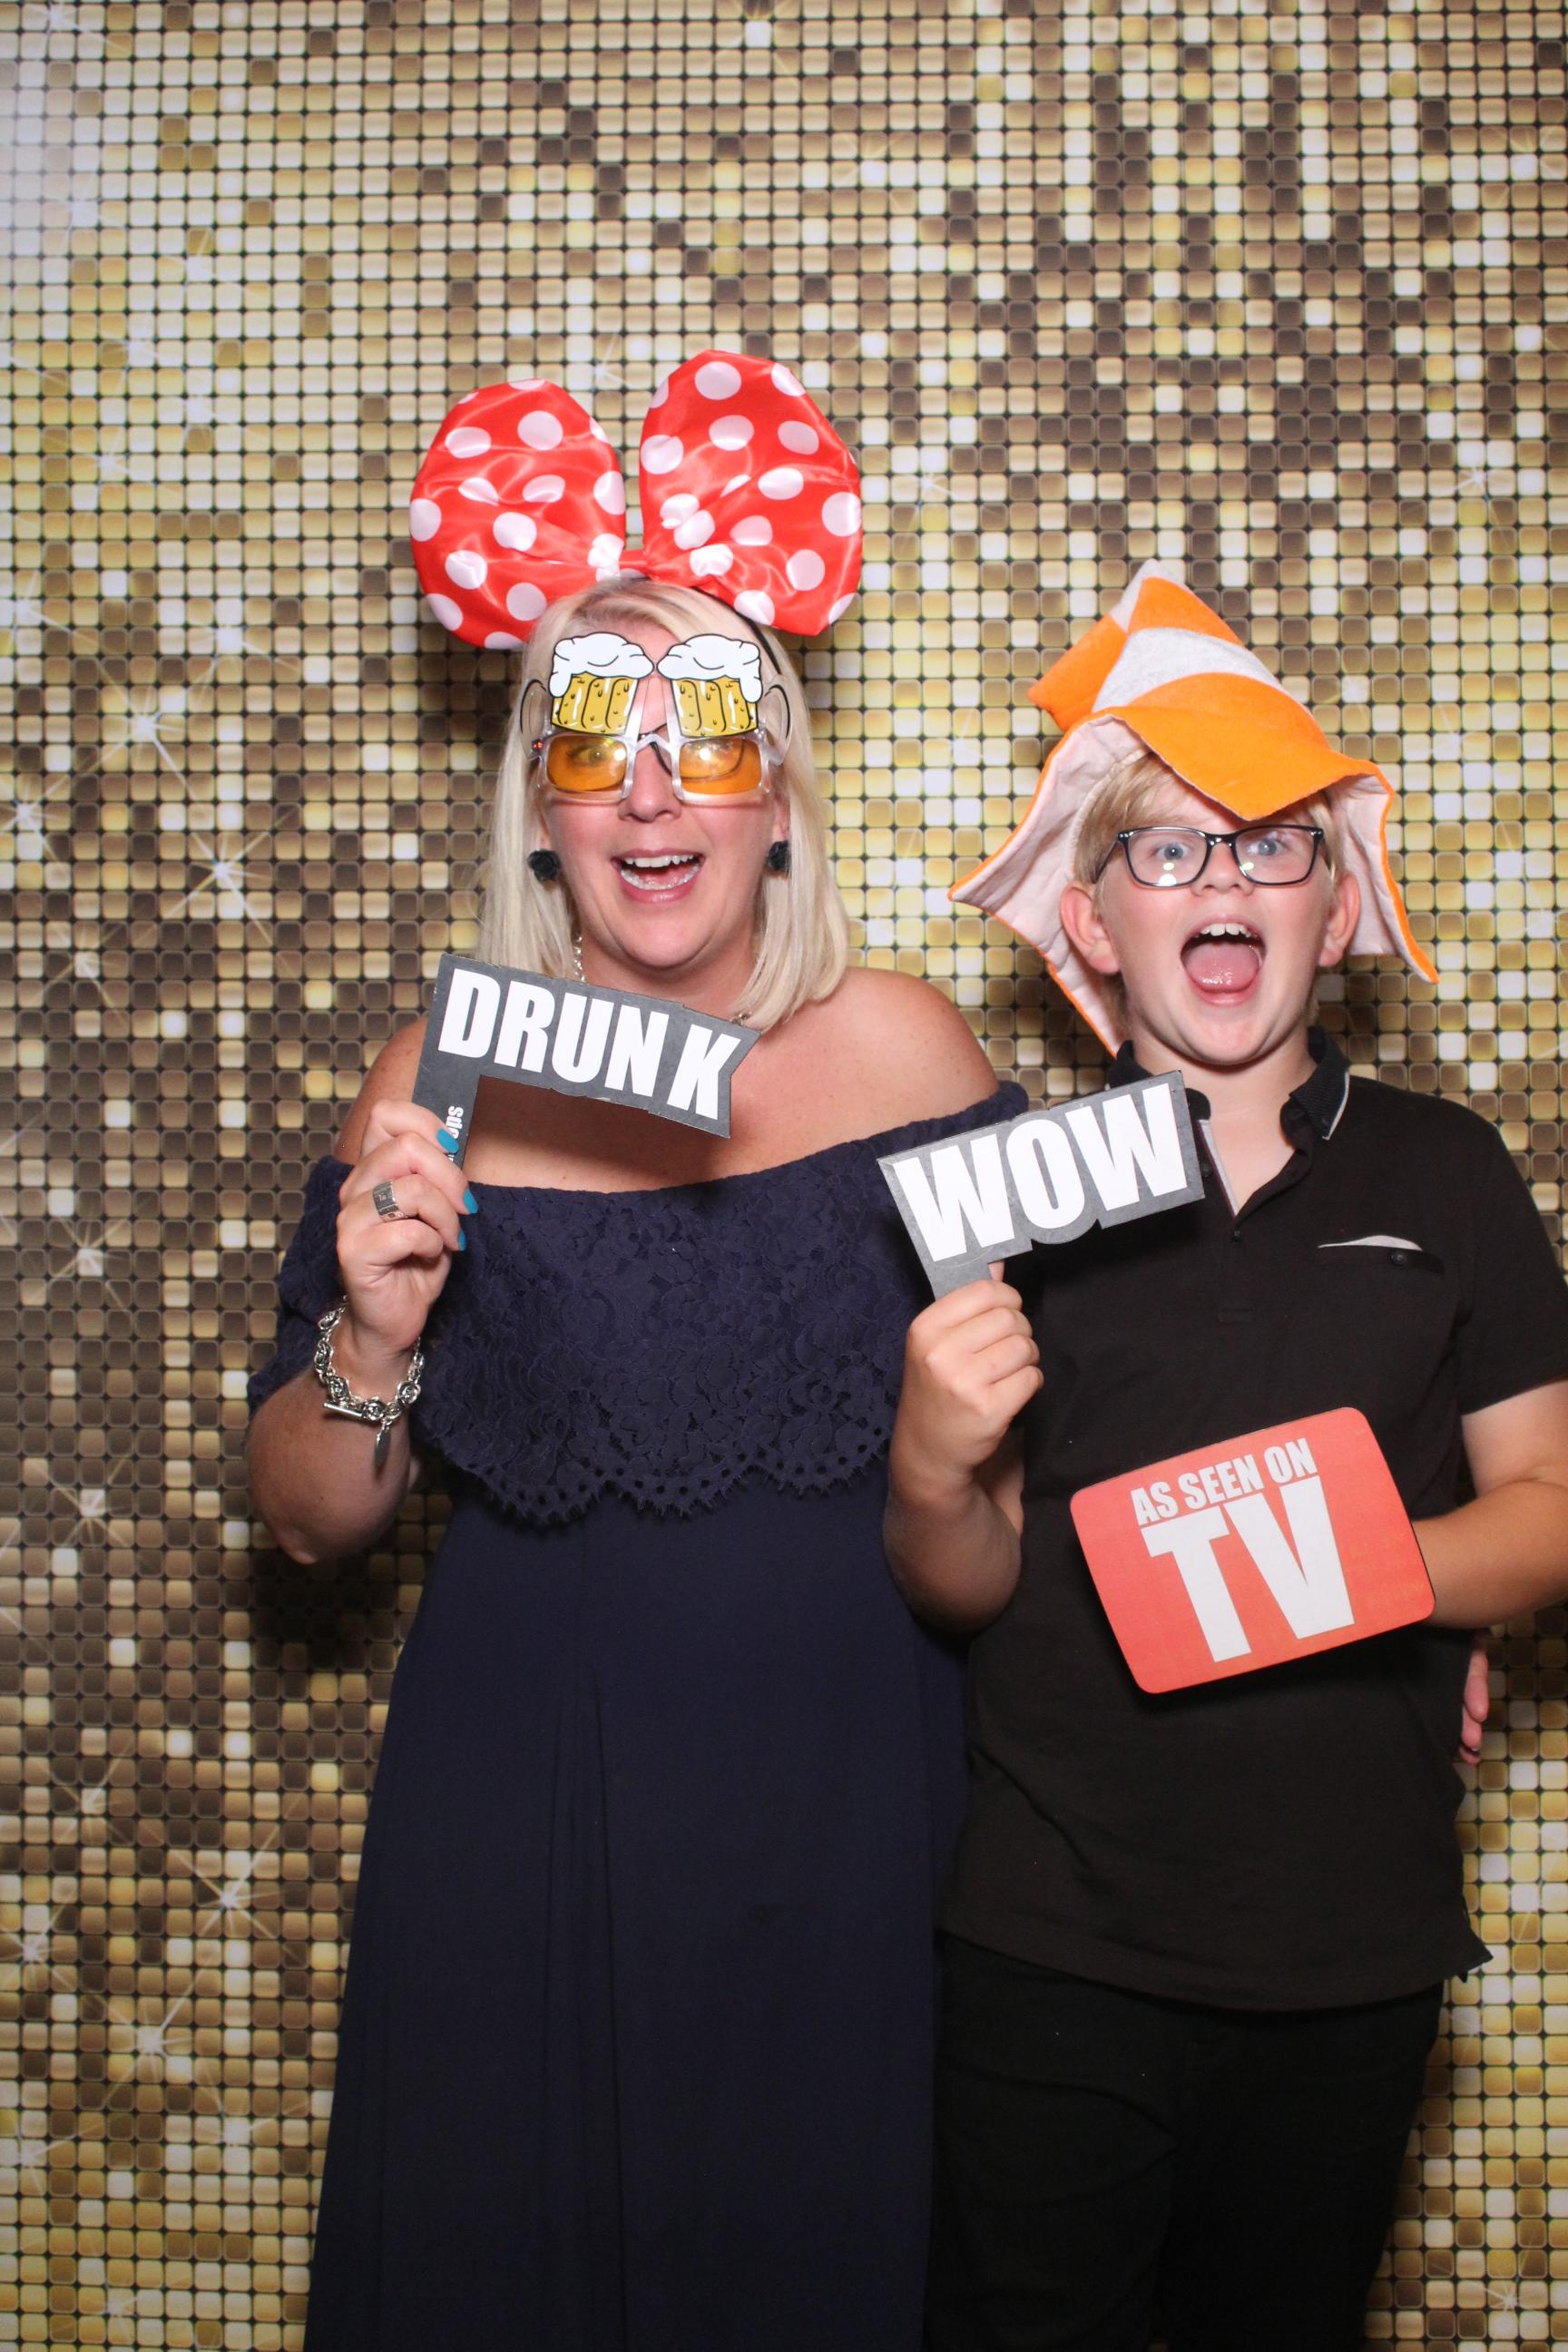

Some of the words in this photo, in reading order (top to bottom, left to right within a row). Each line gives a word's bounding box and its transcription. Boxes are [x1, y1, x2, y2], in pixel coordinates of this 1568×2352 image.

[437, 968, 741, 1121] DRUNK
[892, 1083, 1188, 1262] WOW
[1130, 1480, 1179, 1526] AS
[1177, 1454, 1265, 1511] SEEN
[1263, 1436, 1318, 1485] ON
[1140, 1475, 1356, 1663] TV
